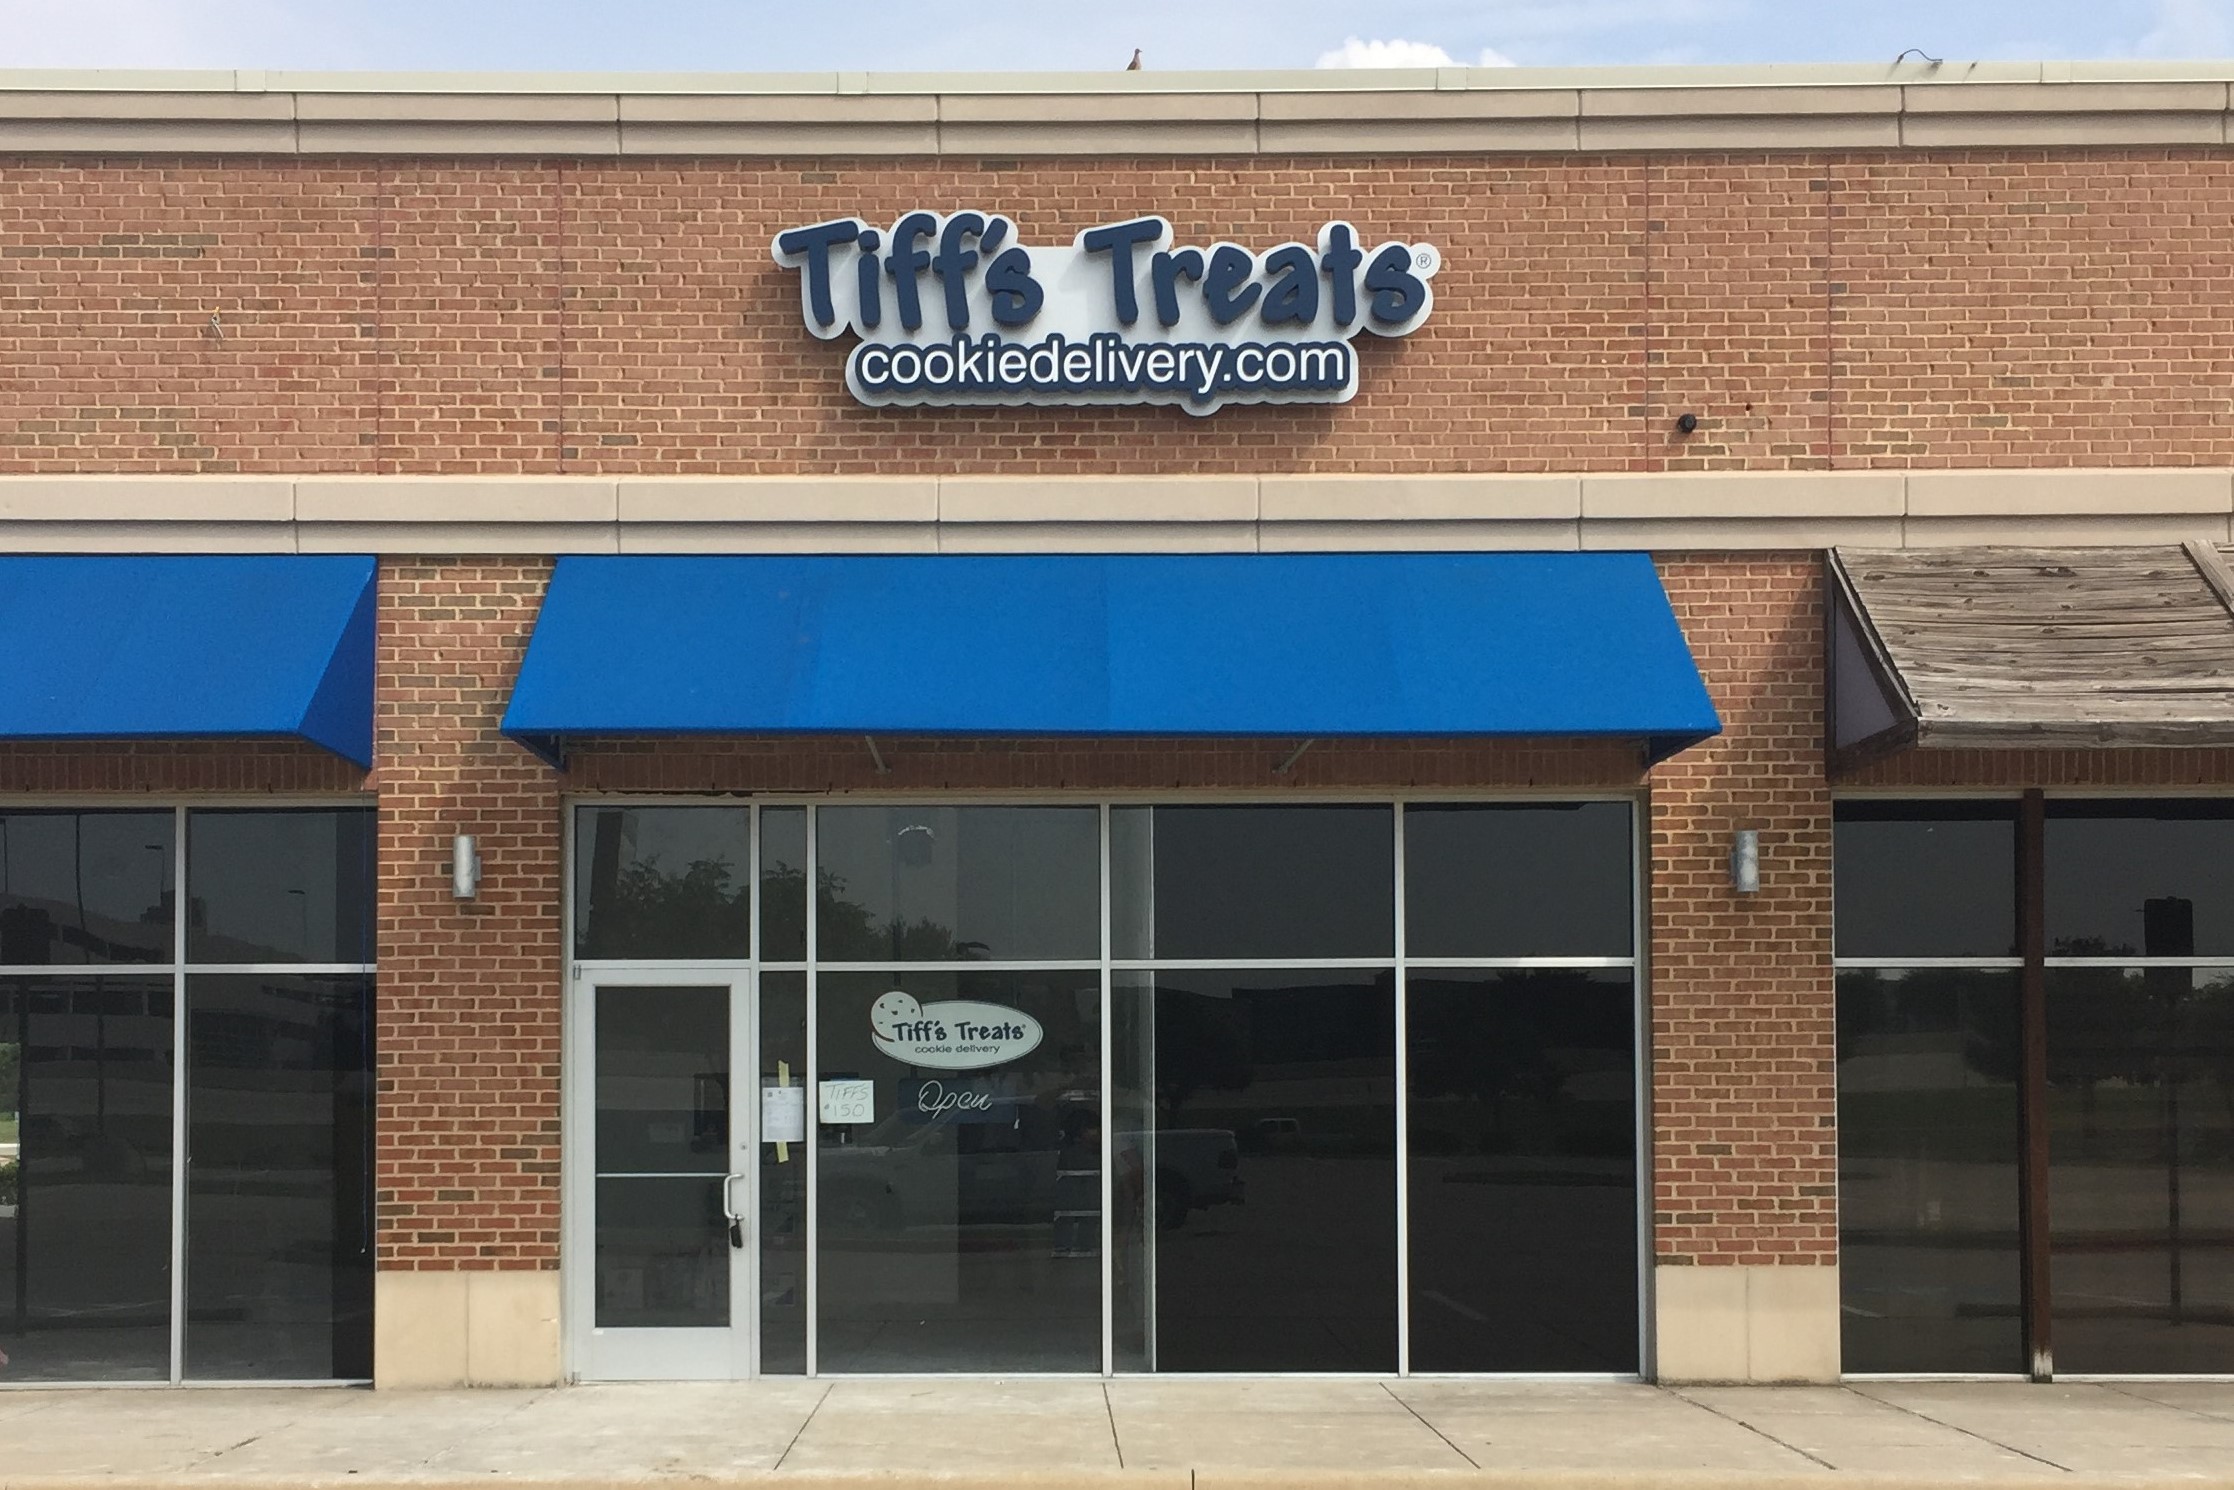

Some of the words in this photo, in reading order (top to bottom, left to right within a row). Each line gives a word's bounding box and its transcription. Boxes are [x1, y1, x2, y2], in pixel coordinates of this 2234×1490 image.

[779, 211, 1044, 329] Tiff's
[862, 339, 1345, 393] cookiedelivery.com
[892, 1020, 947, 1041] Tiff's
[914, 1044, 952, 1054] cookie
[955, 1044, 1000, 1054] delivery
[918, 1080, 992, 1118] Open
